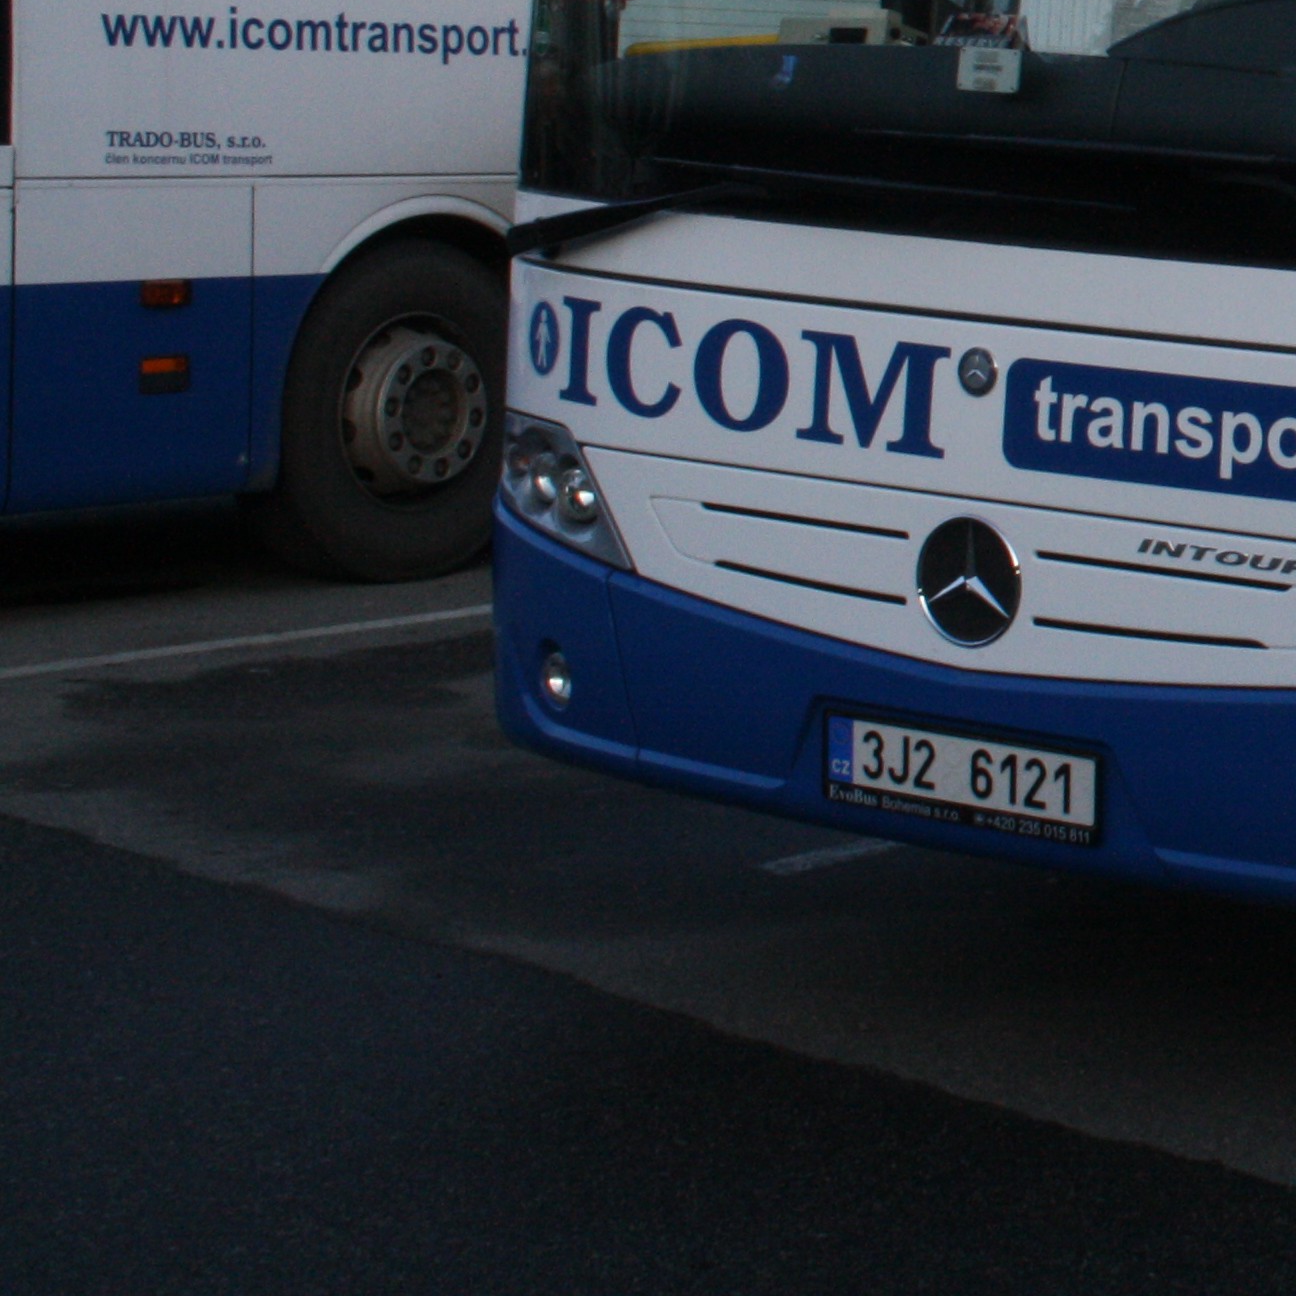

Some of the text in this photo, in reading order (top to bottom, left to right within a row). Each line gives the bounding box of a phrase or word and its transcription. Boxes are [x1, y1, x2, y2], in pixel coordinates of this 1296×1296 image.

[106, 131, 266, 149] TRADO-BUS, s.r.o.
[190, 154, 219, 165] ICOM
[222, 154, 273, 167] transport
[559, 296, 950, 459] ICOM
[831, 759, 851, 776] CZ
[862, 730, 1072, 814] 3J2 6121
[828, 783, 1090, 844] EvoBus Bohemia s.r.o. +420 235 015 811
